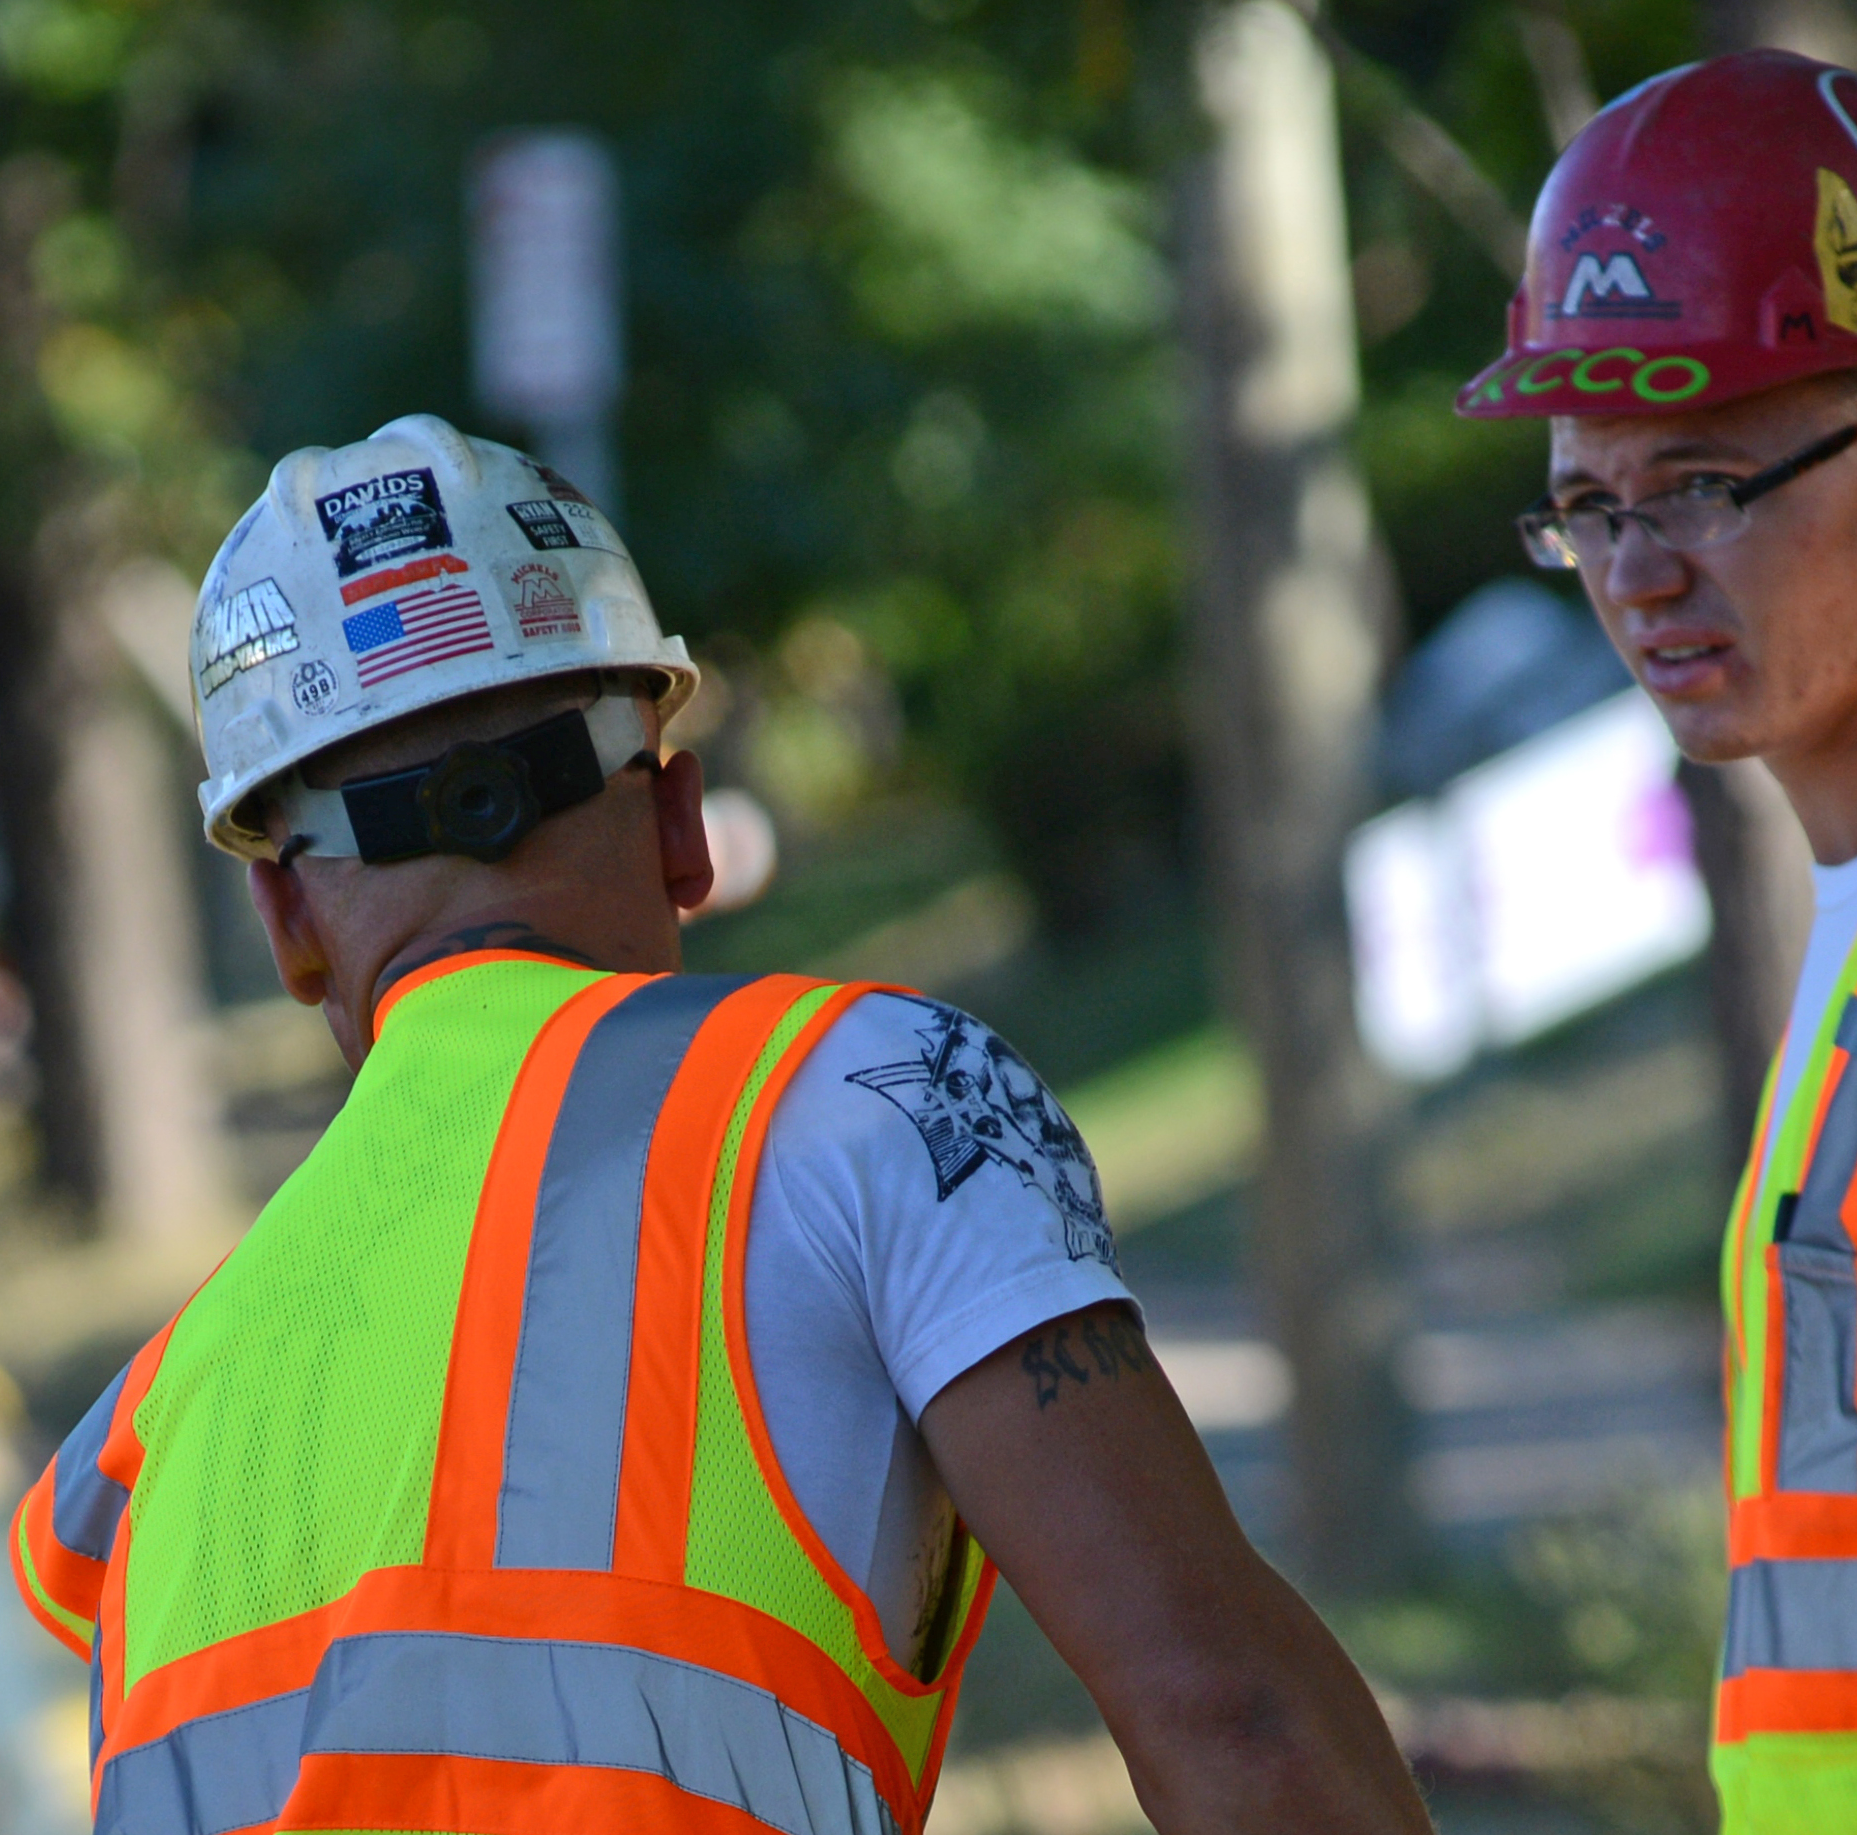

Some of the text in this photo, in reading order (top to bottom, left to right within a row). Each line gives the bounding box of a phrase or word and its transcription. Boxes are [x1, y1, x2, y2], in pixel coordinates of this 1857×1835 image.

[324, 474, 424, 518] DAVIDS
[530, 522, 566, 537] SAFETY
[542, 534, 570, 548] FIRST
[302, 678, 330, 703] 49B
